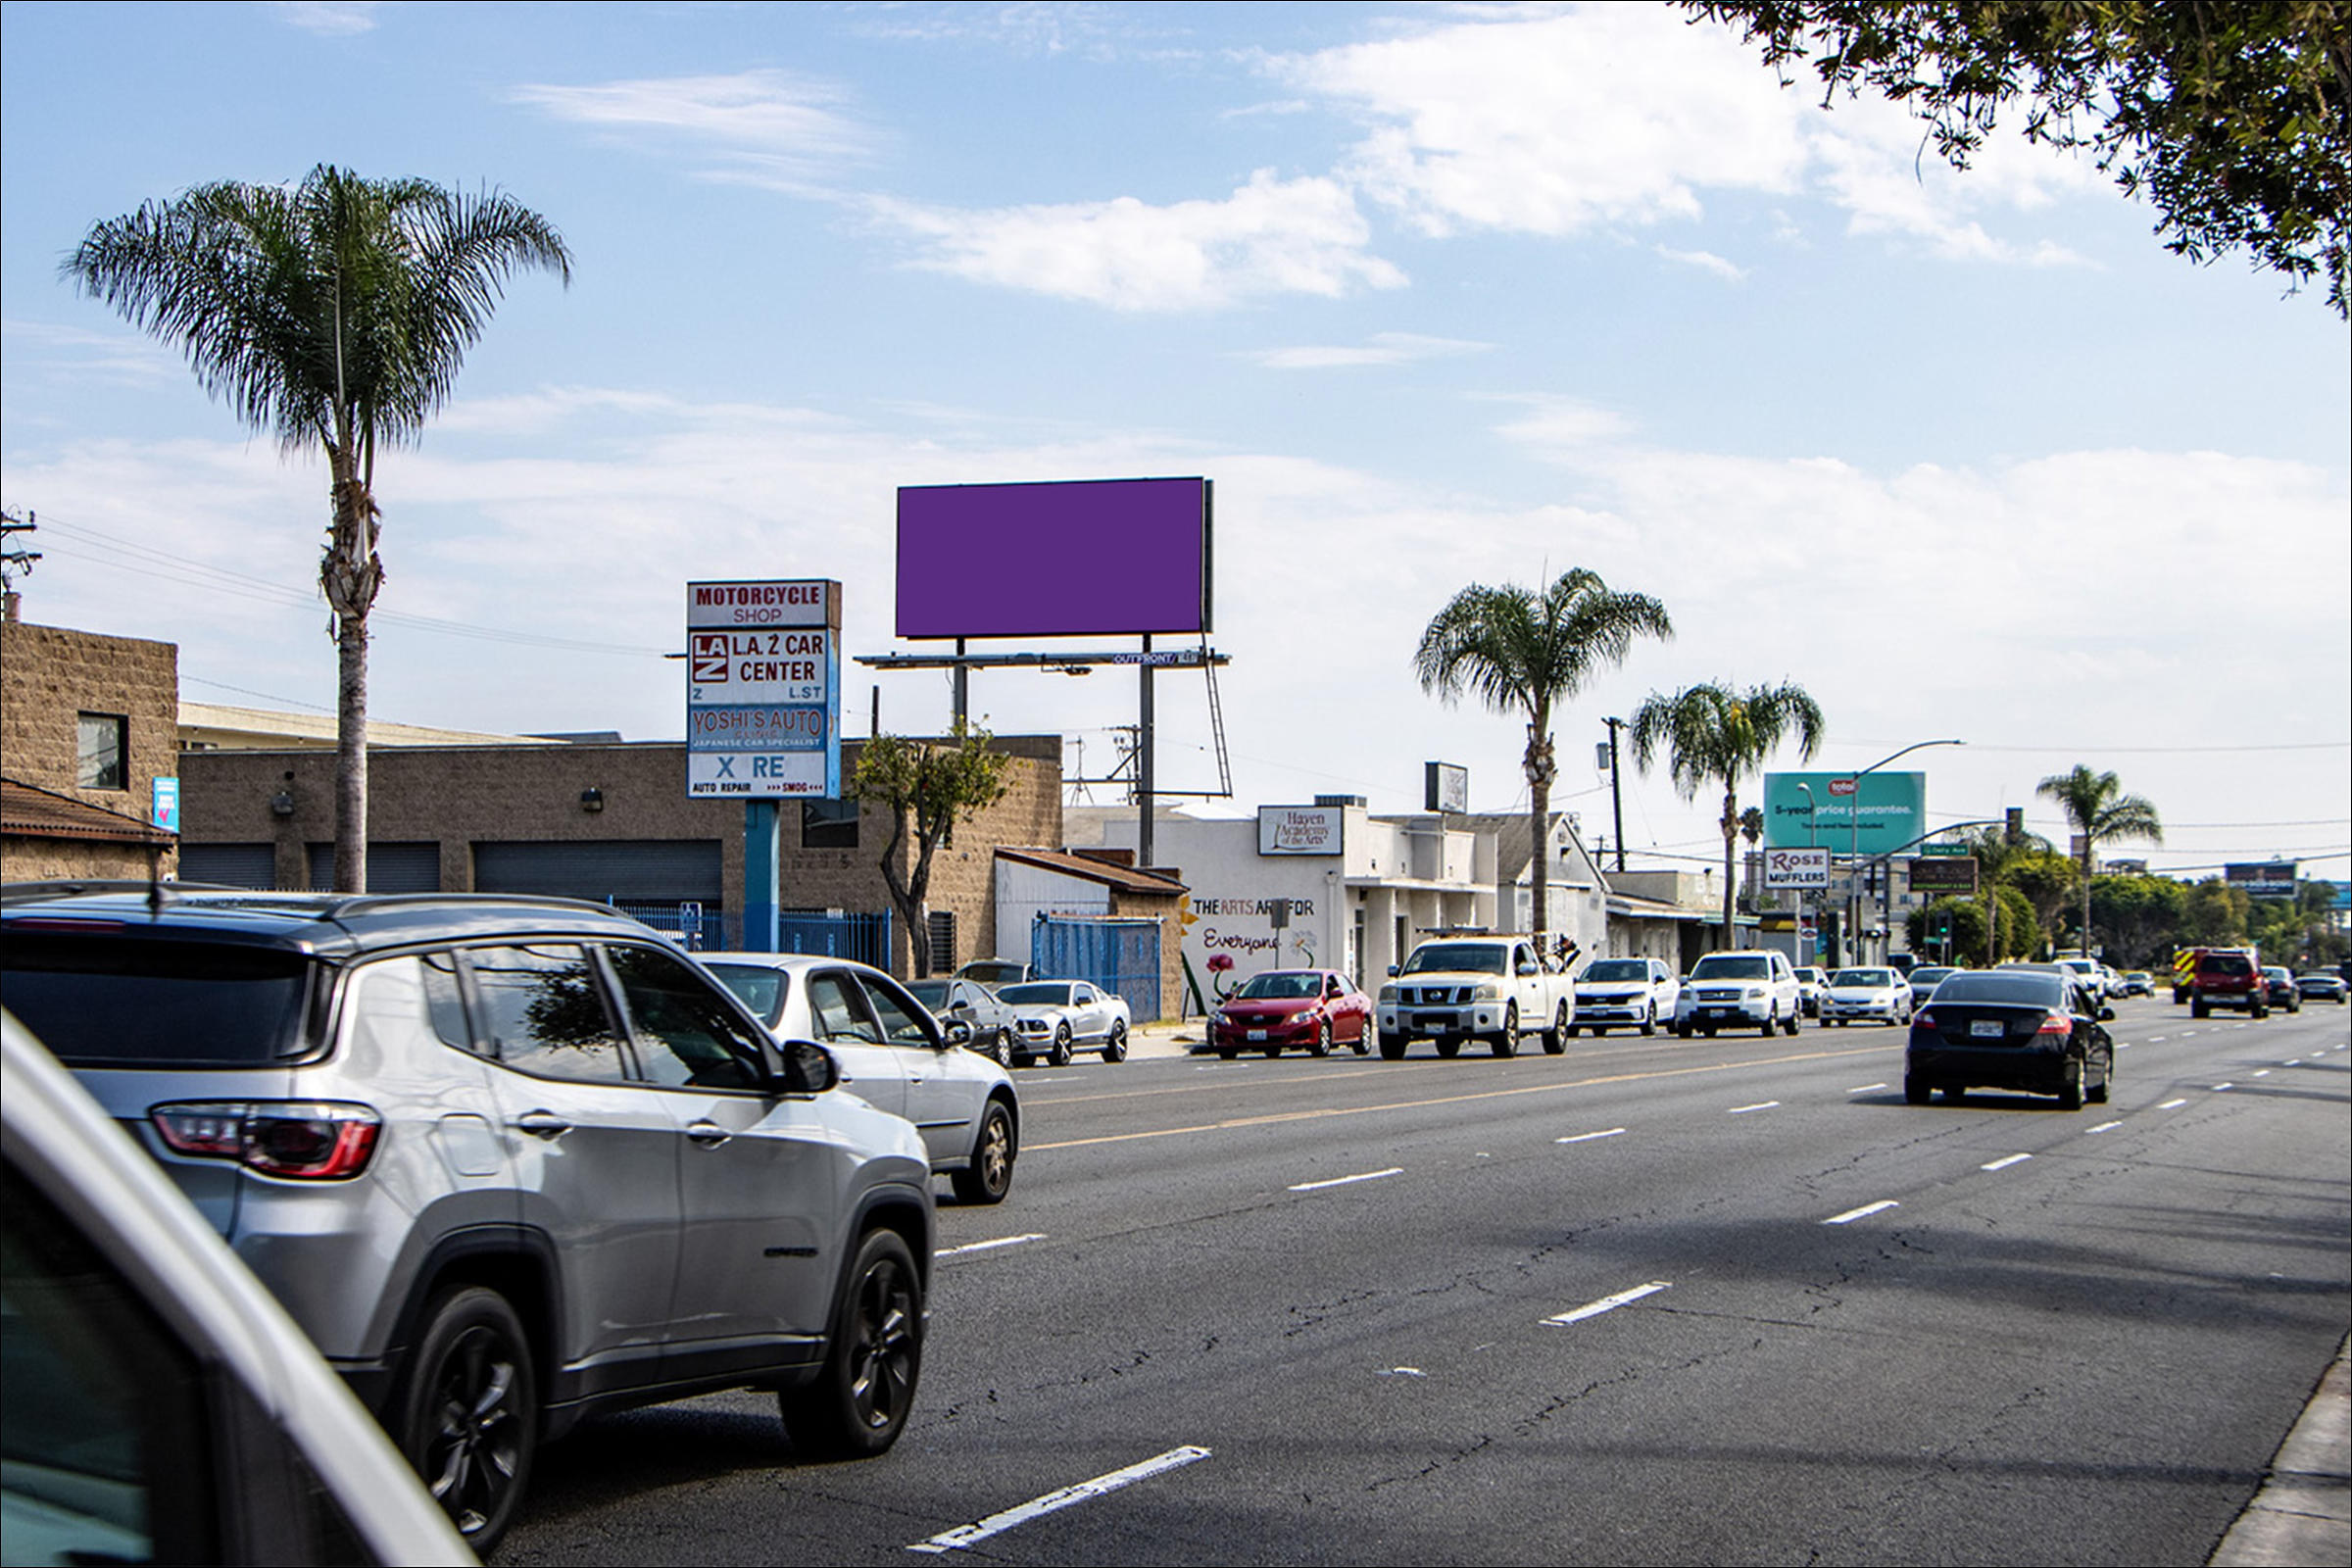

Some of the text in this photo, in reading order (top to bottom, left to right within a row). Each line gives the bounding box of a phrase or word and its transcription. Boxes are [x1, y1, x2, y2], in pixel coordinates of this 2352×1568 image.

[696, 586, 820, 606] MOTORCYCLE
[733, 608, 782, 623] SHOP
[733, 635, 763, 656] L.A.
[785, 635, 823, 656] CAR
[740, 661, 815, 682] CENTER
[693, 688, 703, 700] Z
[693, 710, 822, 736] YOSHI'S AUTO
[735, 730, 778, 739] CLINIC
[716, 756, 784, 778] X RE
[693, 782, 808, 793] AUTO REPAIR SMOG
[1832, 782, 1855, 792] tota
[1816, 804, 1846, 816] price
[1848, 805, 1912, 816] guarantee.
[1288, 811, 1325, 824] Haven
[1281, 824, 1330, 836] Academy
[1291, 836, 1303, 845] the
[1769, 872, 1825, 882] MUFFLERS
[1193, 899, 1220, 914] THE
[1221, 899, 1254, 915] ARTS
[1255, 900, 1275, 914] AR
[1203, 928, 1282, 956] Everyone
